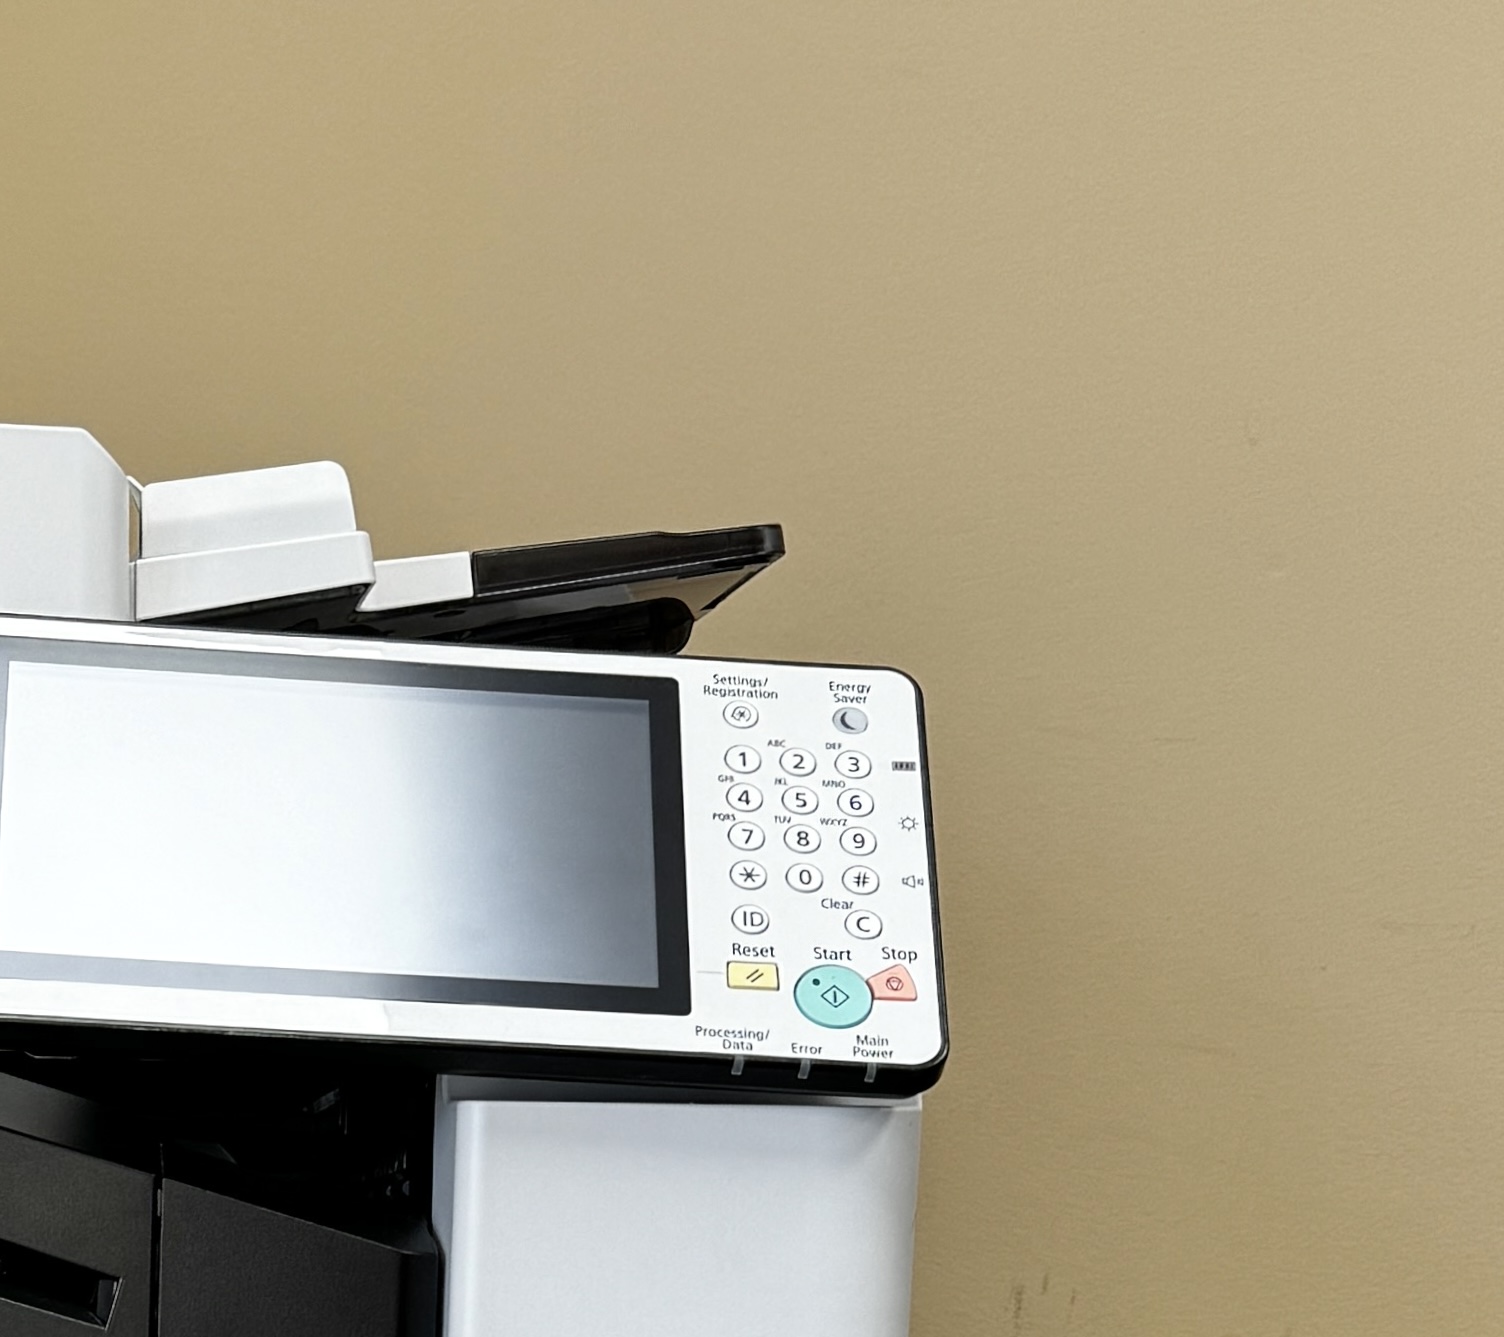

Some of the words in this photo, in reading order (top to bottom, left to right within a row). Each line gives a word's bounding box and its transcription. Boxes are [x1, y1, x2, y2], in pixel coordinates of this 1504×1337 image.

[703, 685, 779, 700] Registration
[833, 692, 868, 704] Saver
[739, 752, 747, 767] 1
[792, 754, 806, 769] 2
[847, 757, 860, 772] 3
[737, 790, 751, 806] 4
[795, 792, 808, 808] 5
[849, 795, 862, 810] 6
[742, 829, 753, 844] 7
[797, 831, 810, 847] 8
[853, 833, 866, 850] 9
[799, 869, 812, 885] 0
[821, 897, 854, 910] Clear
[743, 911, 764, 927] ID
[856, 917, 871, 932] C
[732, 943, 776, 958] Reset
[813, 947, 852, 961] Start
[882, 947, 918, 963] Stop
[695, 1025, 771, 1041] Processing/
[856, 1034, 889, 1047] Main
[722, 1038, 753, 1051] Data
[791, 1042, 822, 1055] Error
[852, 1046, 894, 1059] Power
